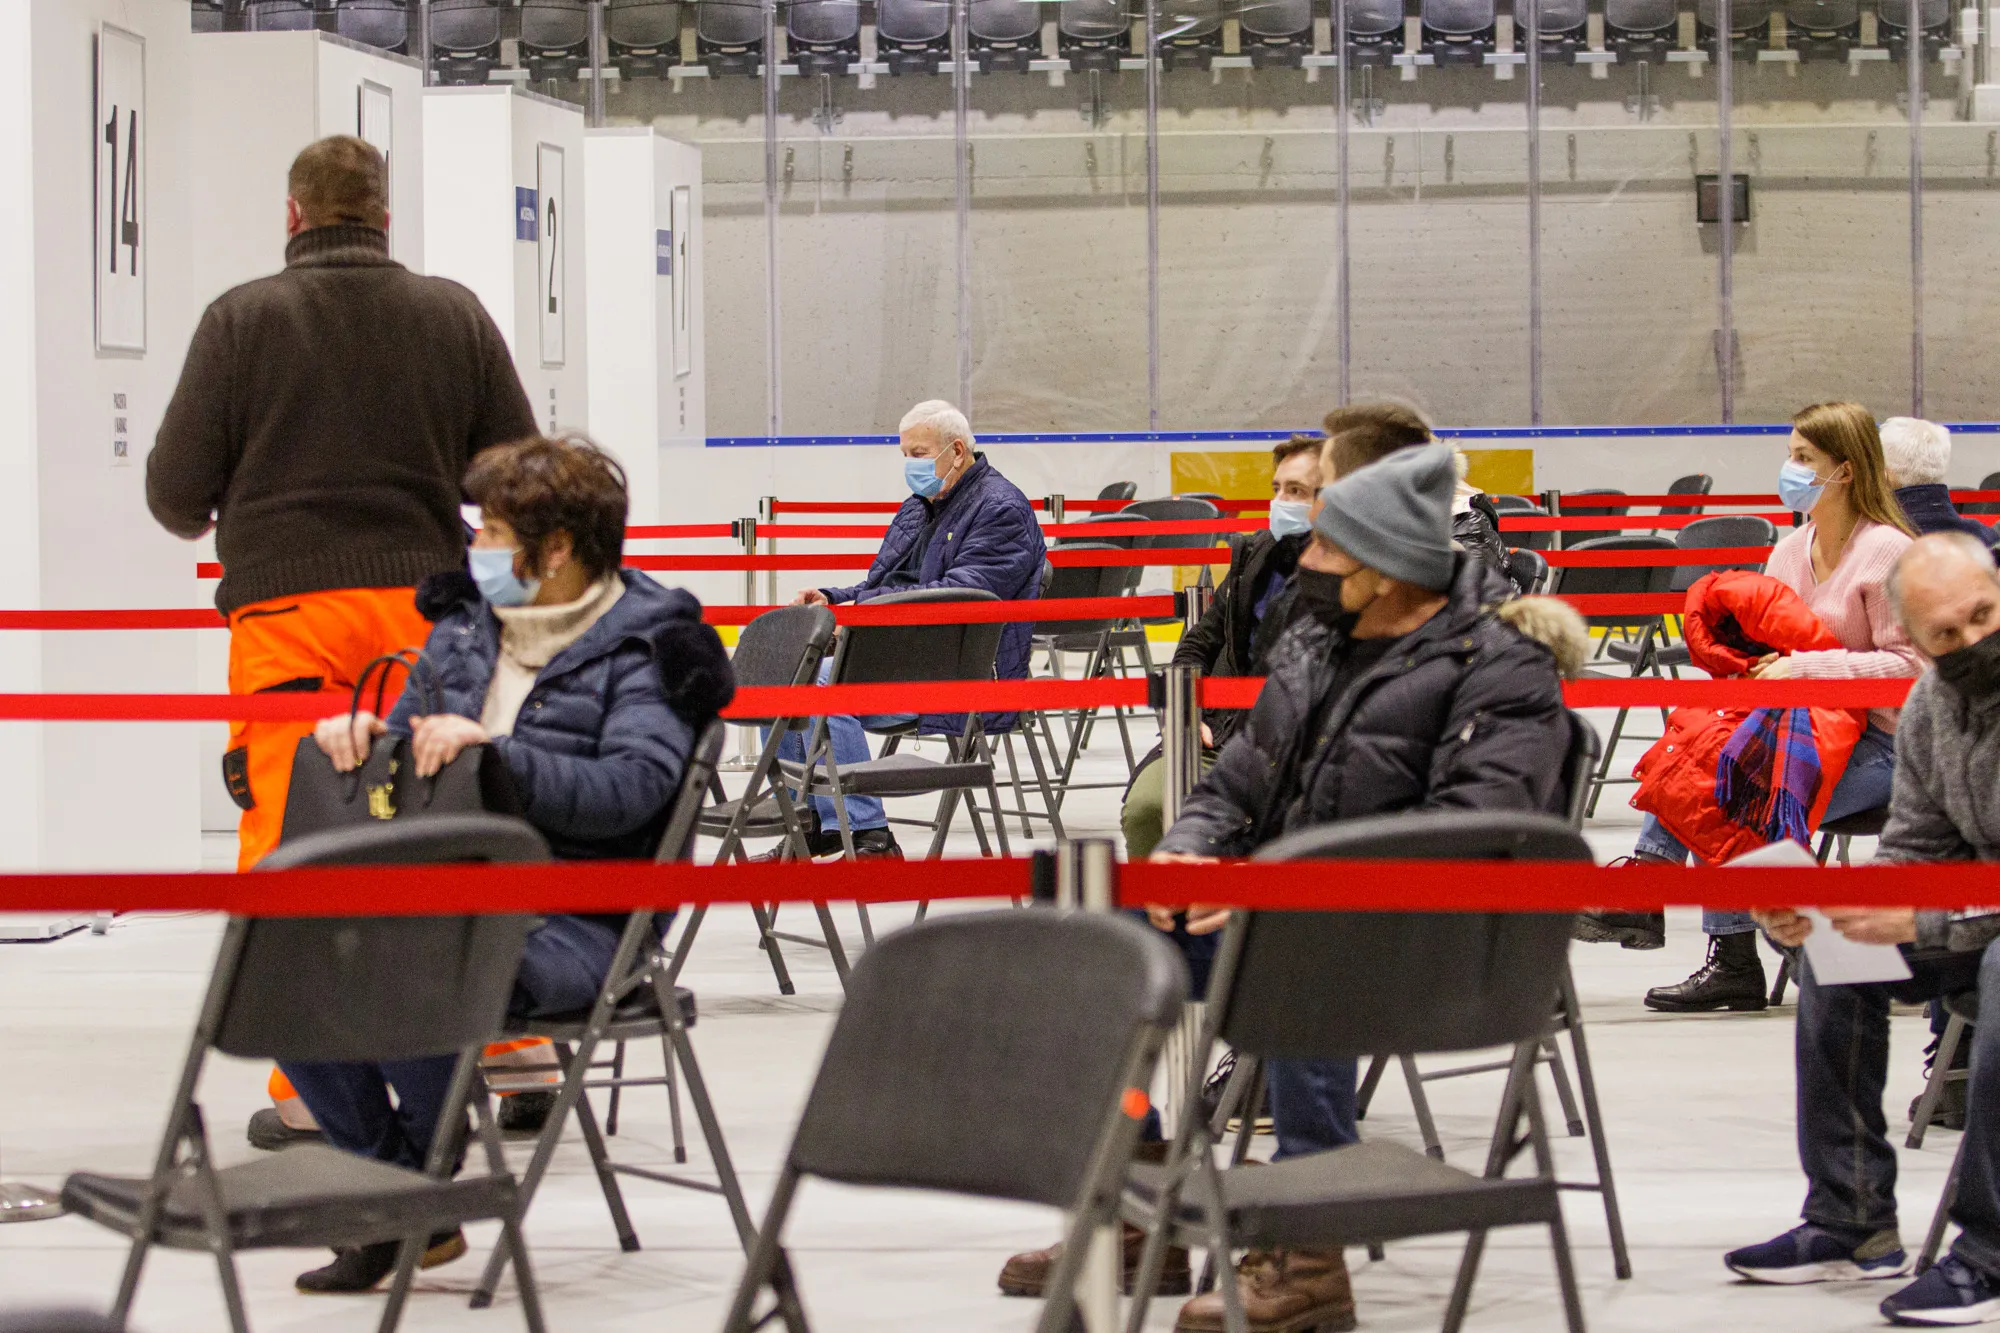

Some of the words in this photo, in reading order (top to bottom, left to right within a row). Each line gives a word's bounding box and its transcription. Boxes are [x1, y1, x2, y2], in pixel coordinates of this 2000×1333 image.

[106, 104, 139, 277] 14
[547, 196, 557, 314] 2
[680, 231, 686, 331] 1
